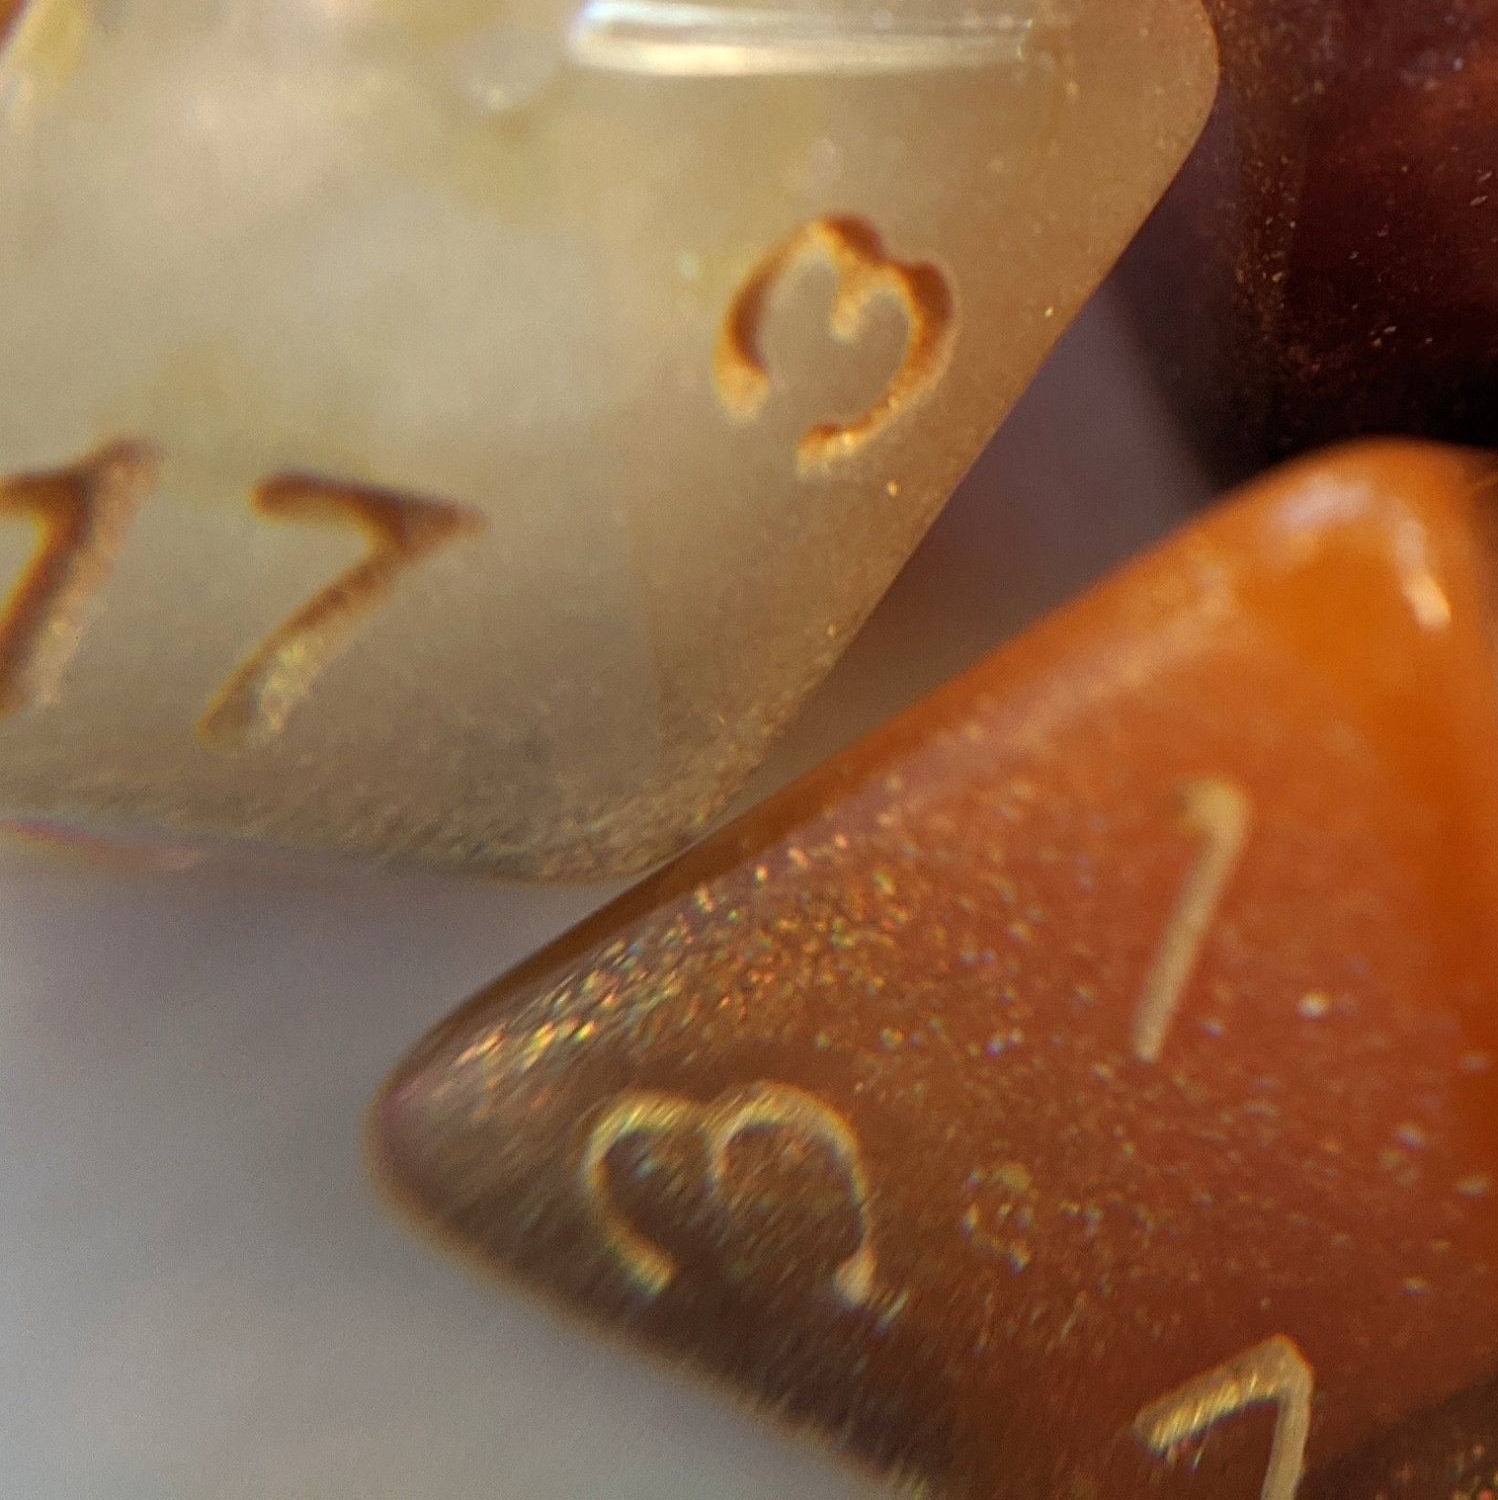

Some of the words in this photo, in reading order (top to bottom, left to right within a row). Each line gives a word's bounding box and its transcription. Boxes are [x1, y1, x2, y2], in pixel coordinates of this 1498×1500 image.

[713, 211, 957, 476] 3
[1133, 772, 1250, 1063] 1
[581, 1078, 882, 1306] 3
